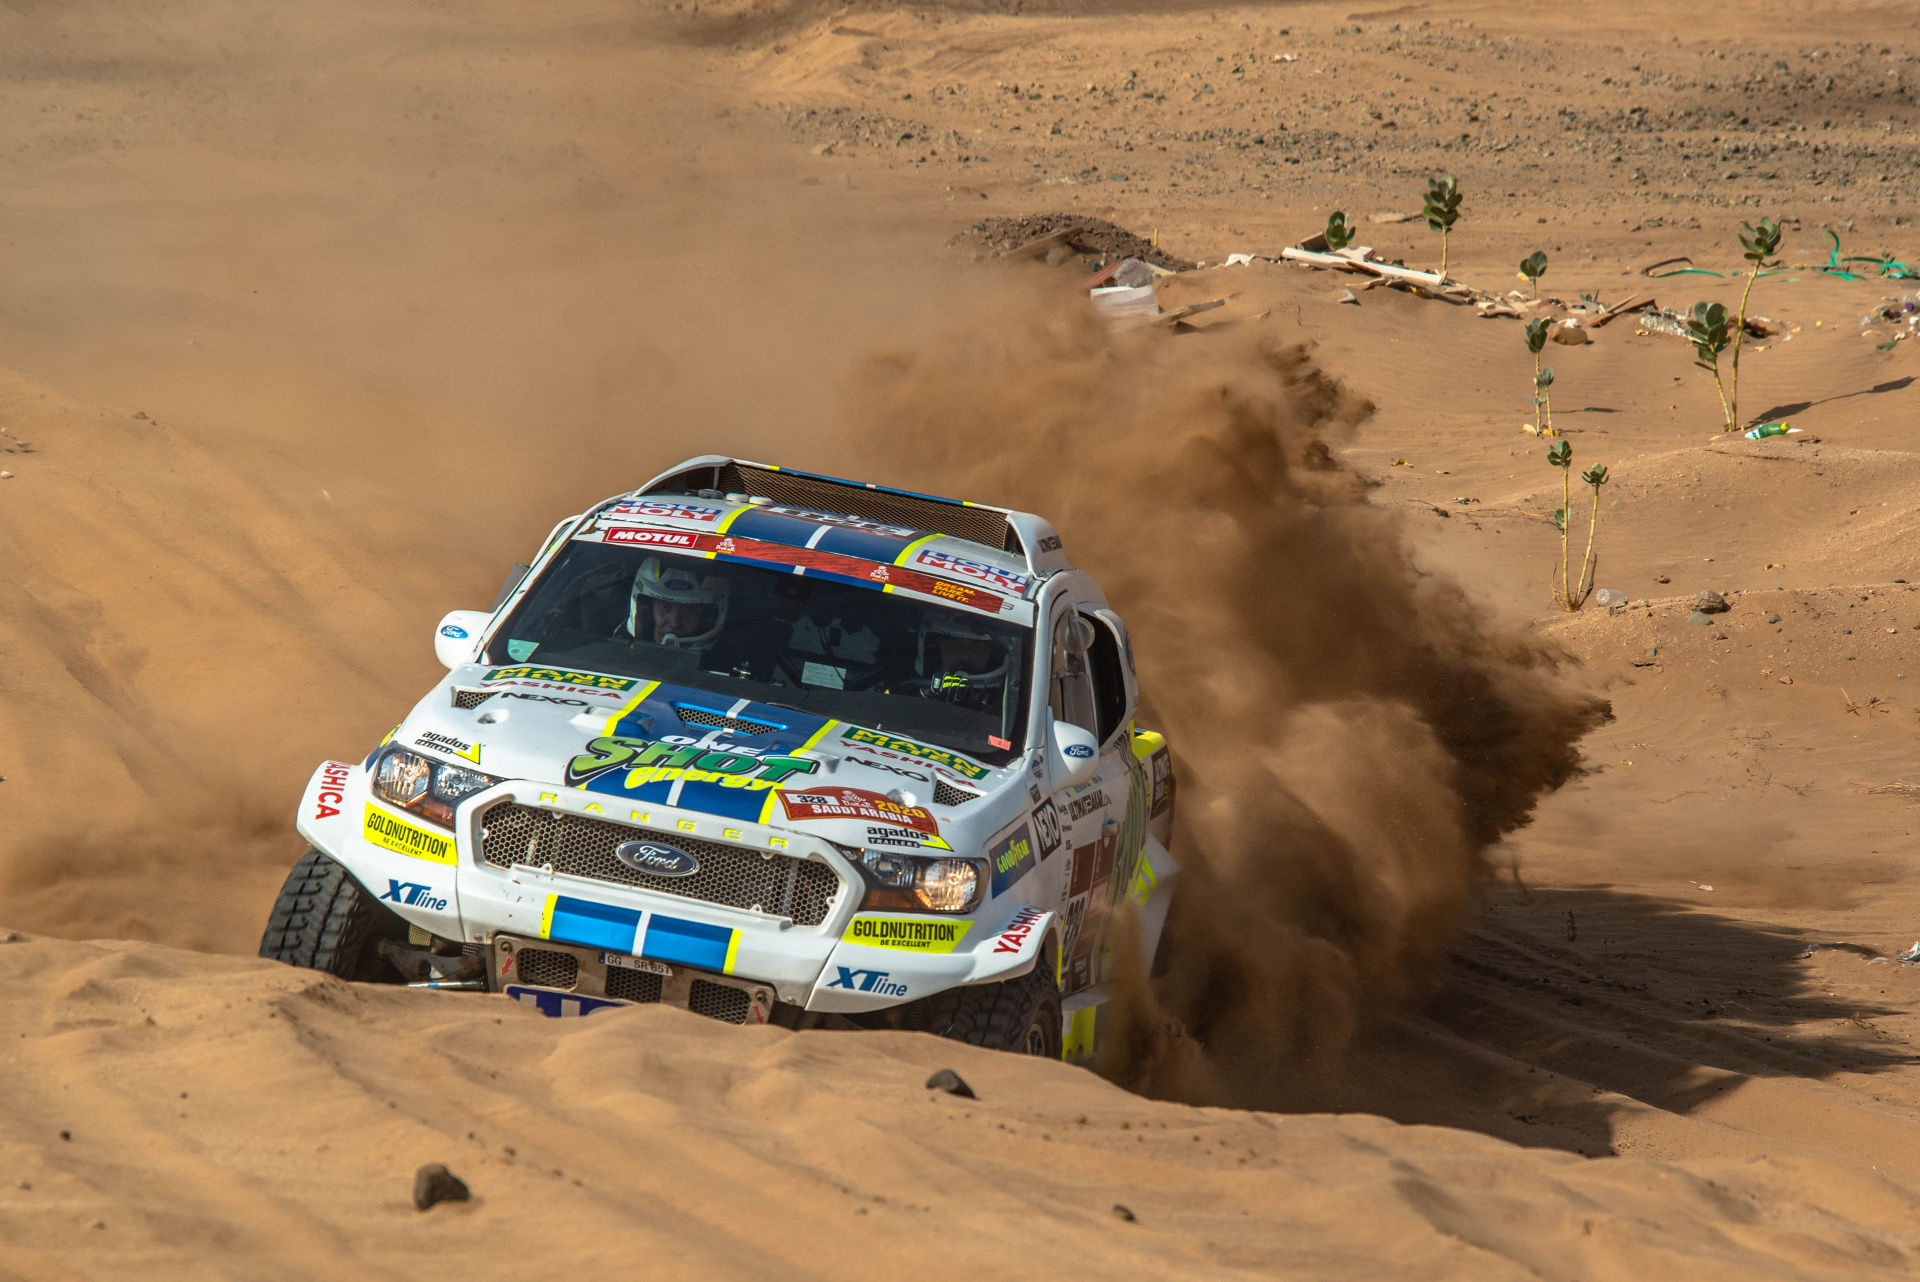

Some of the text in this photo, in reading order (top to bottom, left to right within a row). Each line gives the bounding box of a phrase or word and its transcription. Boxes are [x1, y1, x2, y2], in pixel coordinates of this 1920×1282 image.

[610, 505, 713, 519] MOLY
[612, 531, 690, 545] MOTUL
[922, 556, 1025, 589] MOLY
[926, 551, 1027, 585] LIQUI
[932, 589, 957, 598] LIVE
[936, 581, 975, 595] DREAM.
[492, 673, 622, 690] FILTER
[498, 667, 628, 685] MANN
[480, 680, 622, 699] YASHICA
[500, 692, 588, 706] NEXO
[422, 731, 470, 751] agados
[660, 735, 764, 757] ONE
[565, 736, 820, 787] SHOT
[851, 735, 976, 778] FILTER
[856, 730, 981, 774] MANN
[839, 740, 977, 787] YASHICA
[844, 756, 929, 782] NEXO
[625, 766, 779, 791] energy
[797, 795, 828, 804] 328
[875, 800, 927, 818] 2020
[811, 804, 913, 825] SAUDI ARABIA
[540, 792, 788, 849] RANGER
[367, 812, 448, 859] GOLDNUTRITION
[867, 827, 930, 841] agados
[870, 837, 919, 848] TRAILERS
[383, 837, 423, 857] BE EXCELLENT
[634, 845, 679, 871] Ford
[380, 878, 448, 911] XTline
[853, 920, 955, 941] GOLDNUTRITION
[880, 939, 931, 948] BE EXCELLENT
[607, 954, 622, 966] GG
[634, 959, 648, 969] SR
[826, 966, 908, 997] XTline
